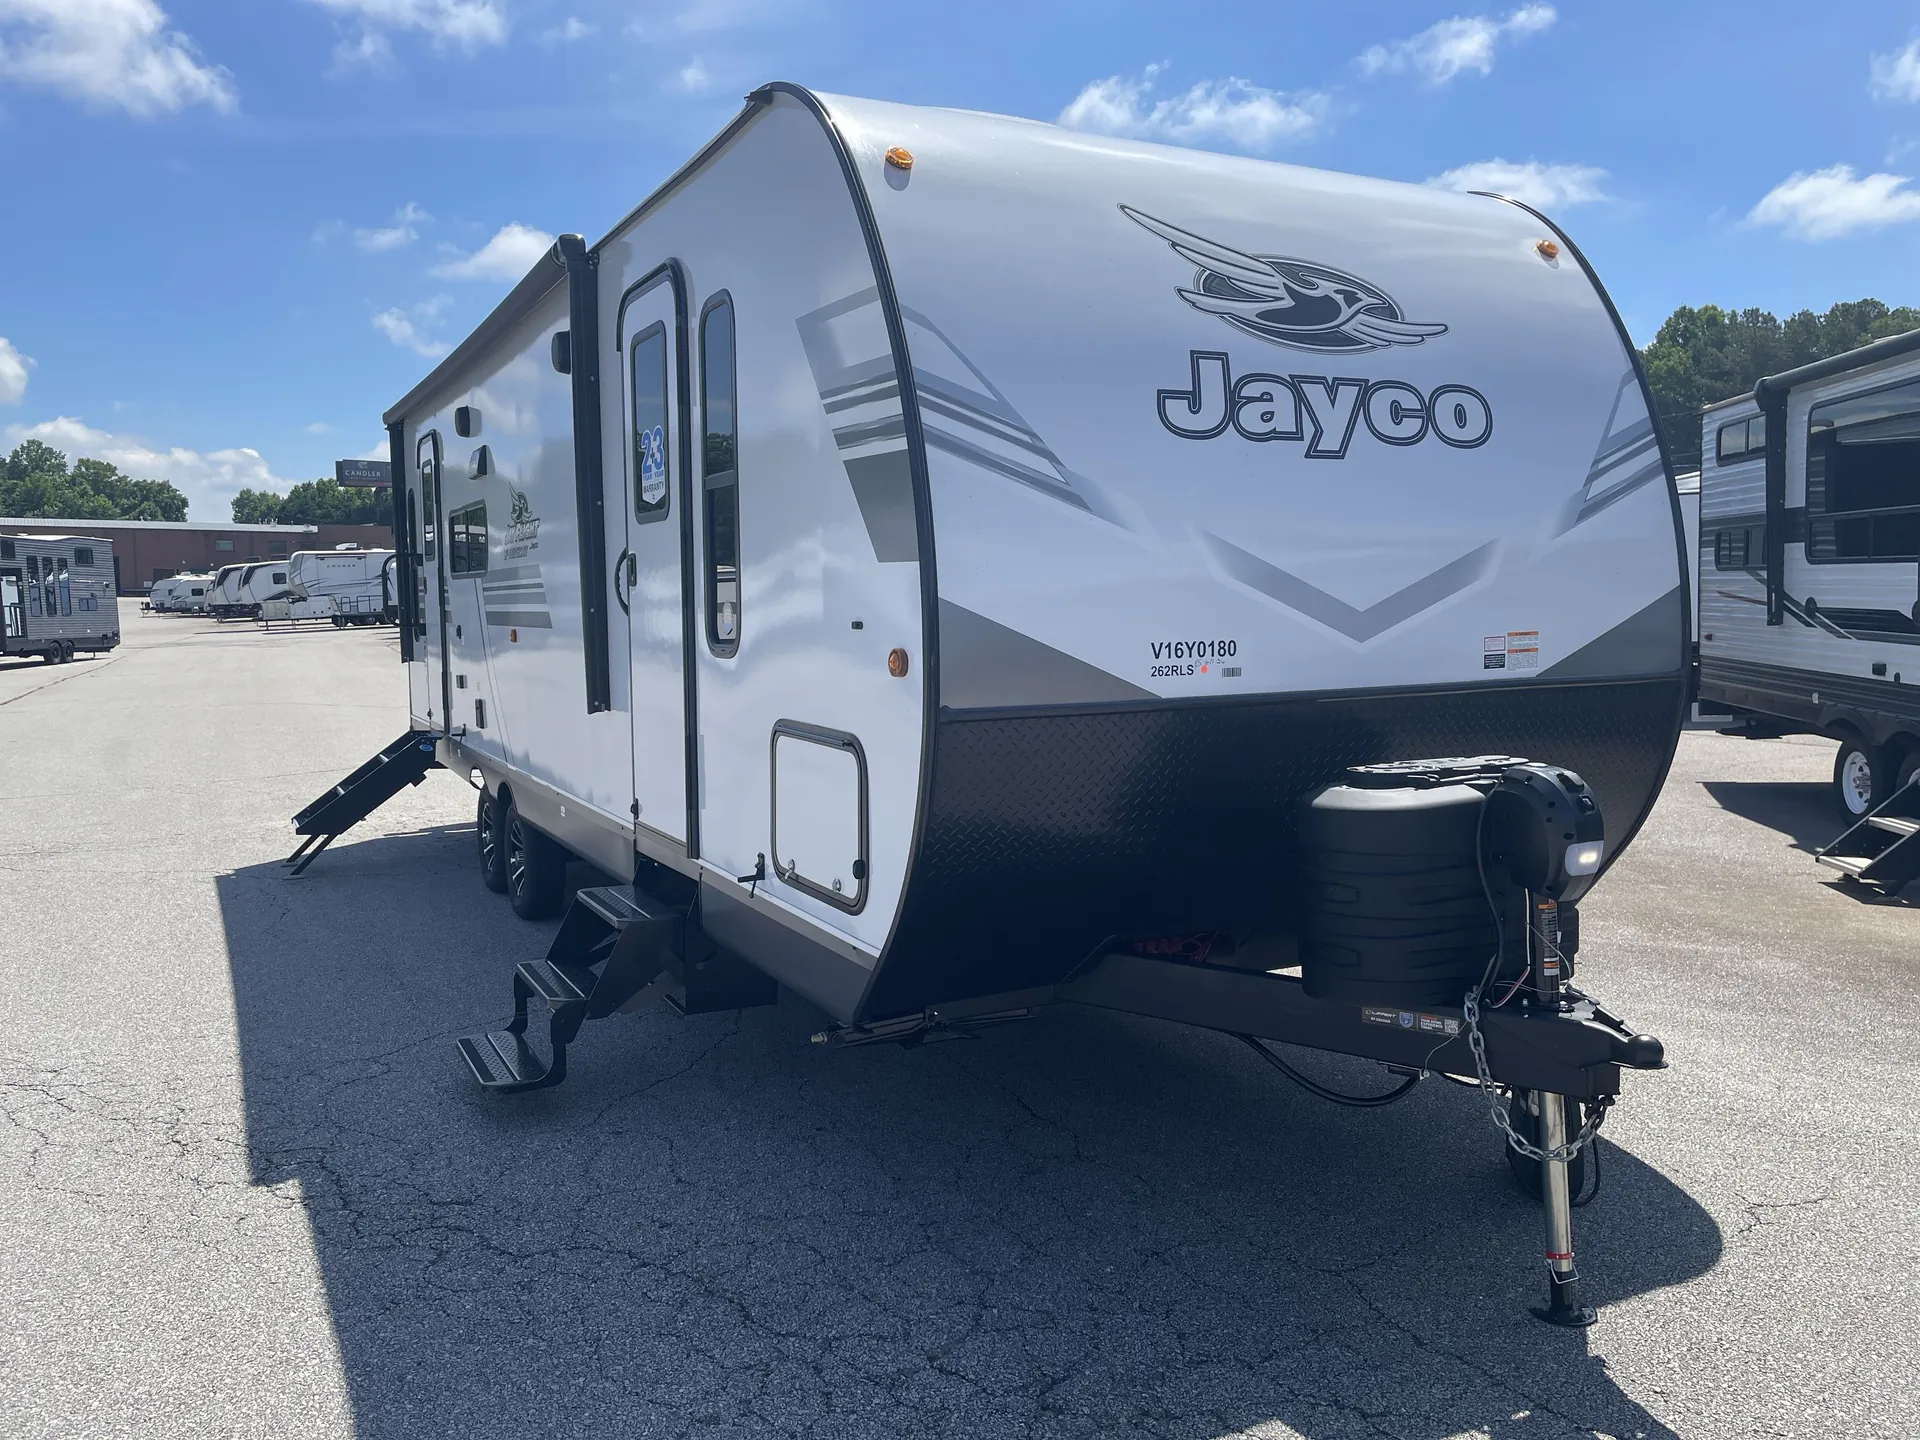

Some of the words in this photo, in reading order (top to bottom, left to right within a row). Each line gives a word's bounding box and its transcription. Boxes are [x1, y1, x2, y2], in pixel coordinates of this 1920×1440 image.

[1157, 350, 1493, 459] Jayco
[644, 481, 664, 493] WARRANTY
[1150, 640, 1237, 660] V16Y0180
[1150, 664, 1195, 677] 262RLS
